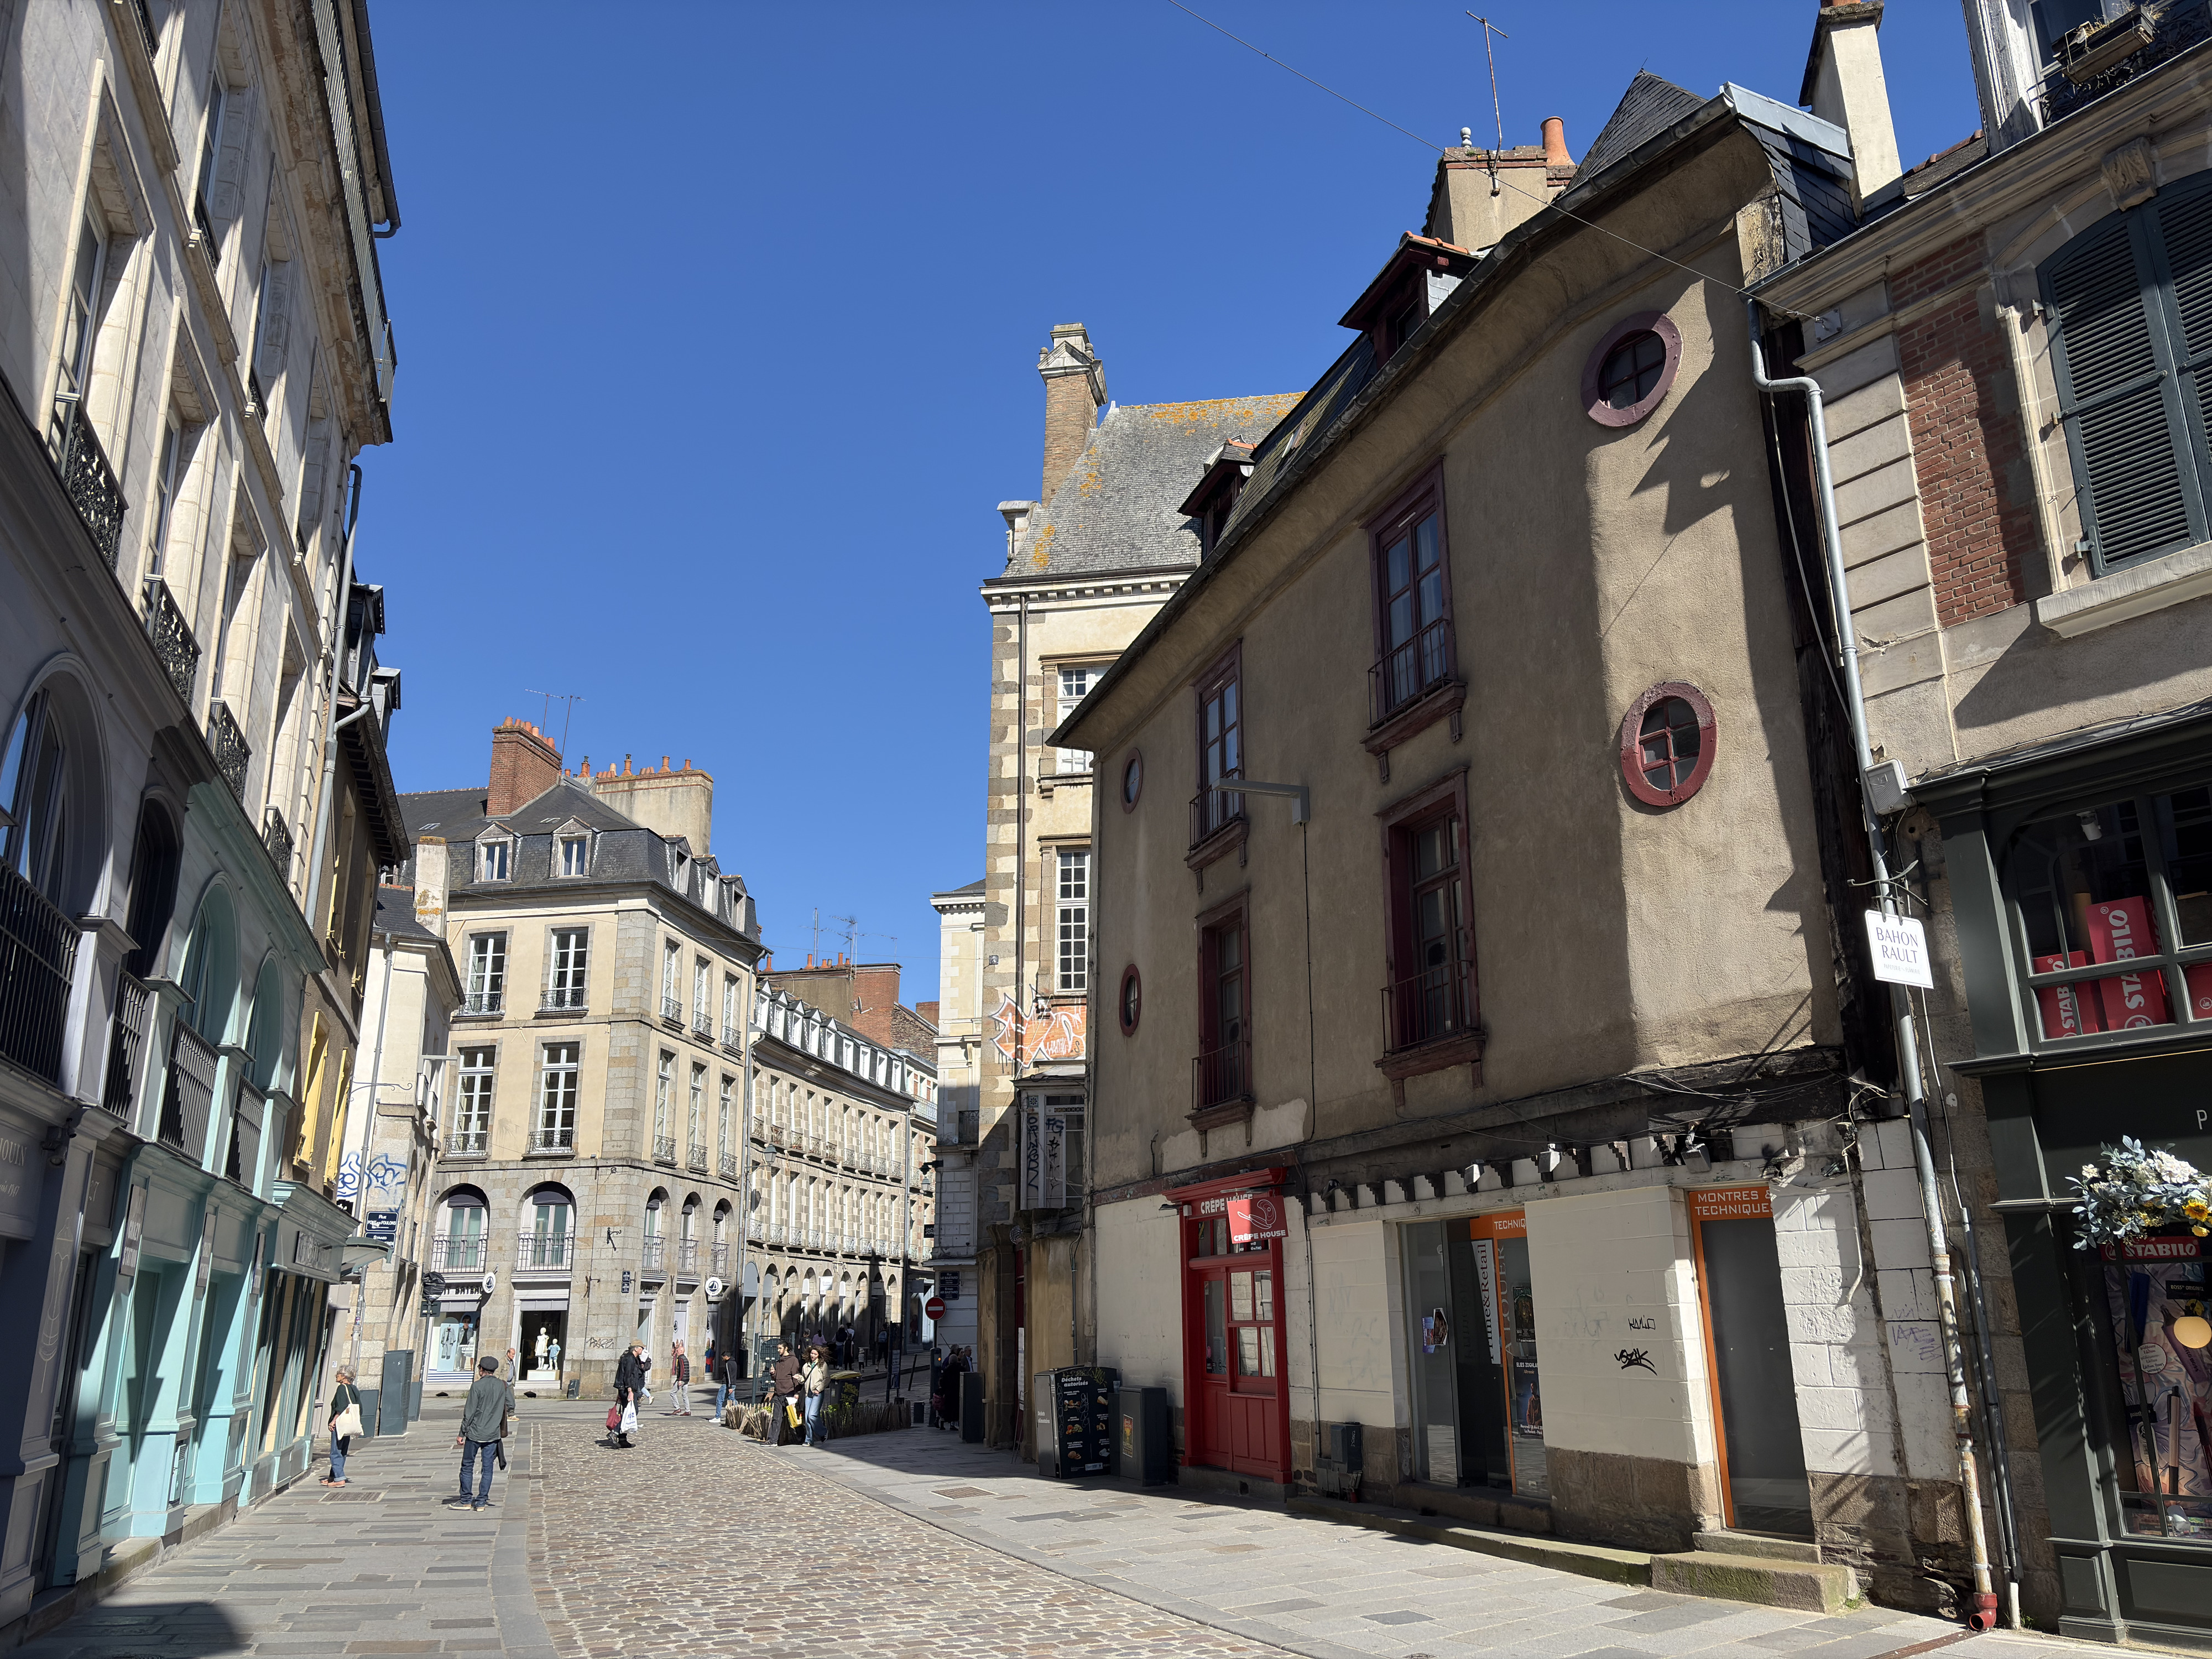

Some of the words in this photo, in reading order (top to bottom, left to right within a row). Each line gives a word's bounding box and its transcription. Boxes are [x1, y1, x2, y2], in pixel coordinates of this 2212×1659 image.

[1876, 927, 1918, 947] BAHON
[1881, 945, 1918, 963] RAULT
[1698, 1191, 1759, 1203] MONTRES
[1201, 1198, 1225, 1214] CRÊPE
[1233, 1233, 1259, 1242] CRÊPE
[1260, 1229, 1286, 1239] HOUSE
